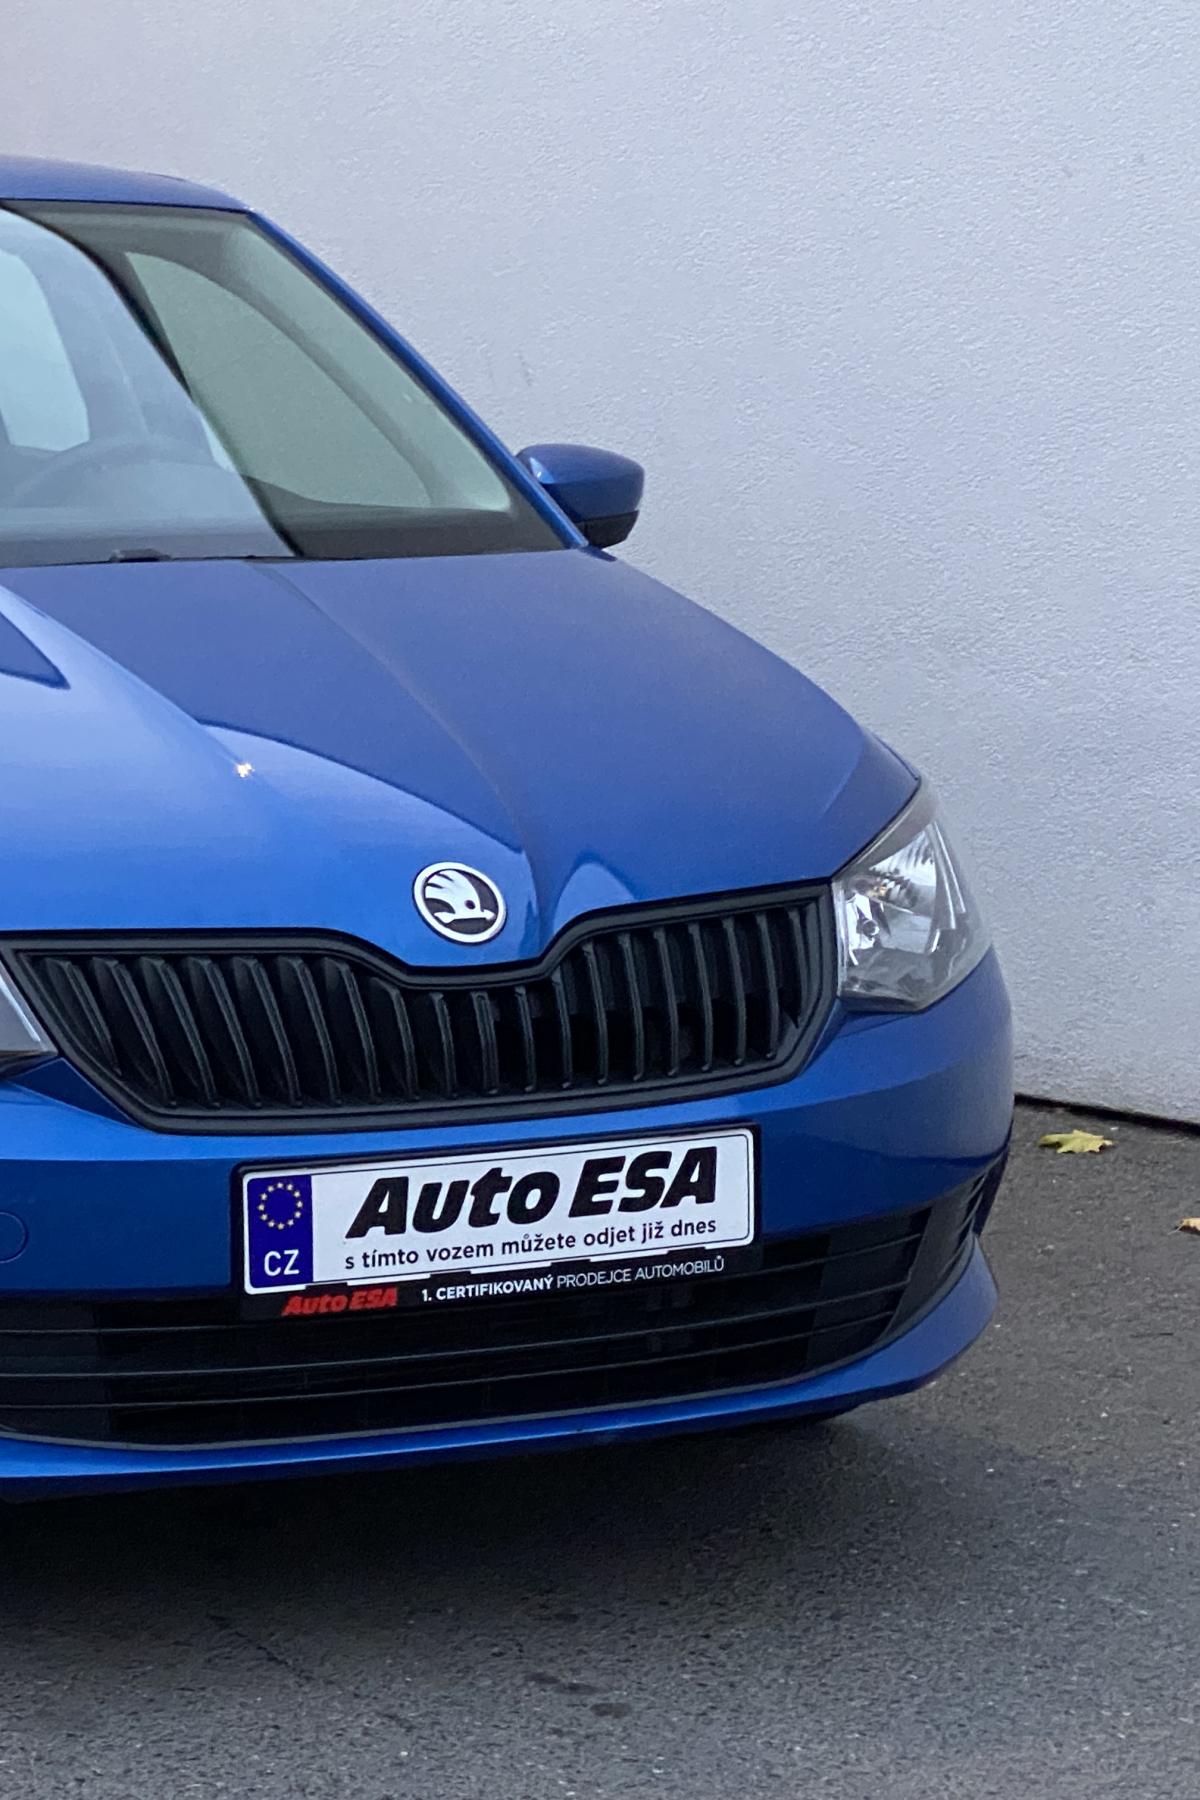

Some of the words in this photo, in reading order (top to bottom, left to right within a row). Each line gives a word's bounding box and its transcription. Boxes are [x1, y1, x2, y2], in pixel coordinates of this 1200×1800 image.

[345, 1167, 560, 1239] Auto
[568, 1146, 717, 1218] ESA
[263, 1249, 300, 1277] CZ
[345, 1256, 354, 1270] s
[362, 1249, 419, 1268] tímto
[426, 1243, 494, 1262] vozem
[502, 1233, 576, 1255] můžete
[583, 1226, 635, 1247] odjet
[641, 1221, 664, 1244] již
[671, 1219, 716, 1237] dnes
[281, 1294, 348, 1316] Auto
[349, 1287, 397, 1310] ESA
[421, 1288, 432, 1302] 1.
[435, 1274, 553, 1300] CERTIFIKOVANÝ
[557, 1268, 631, 1288] PRODEJCE
[634, 1255, 724, 1280] AUTOMOBILŮ
